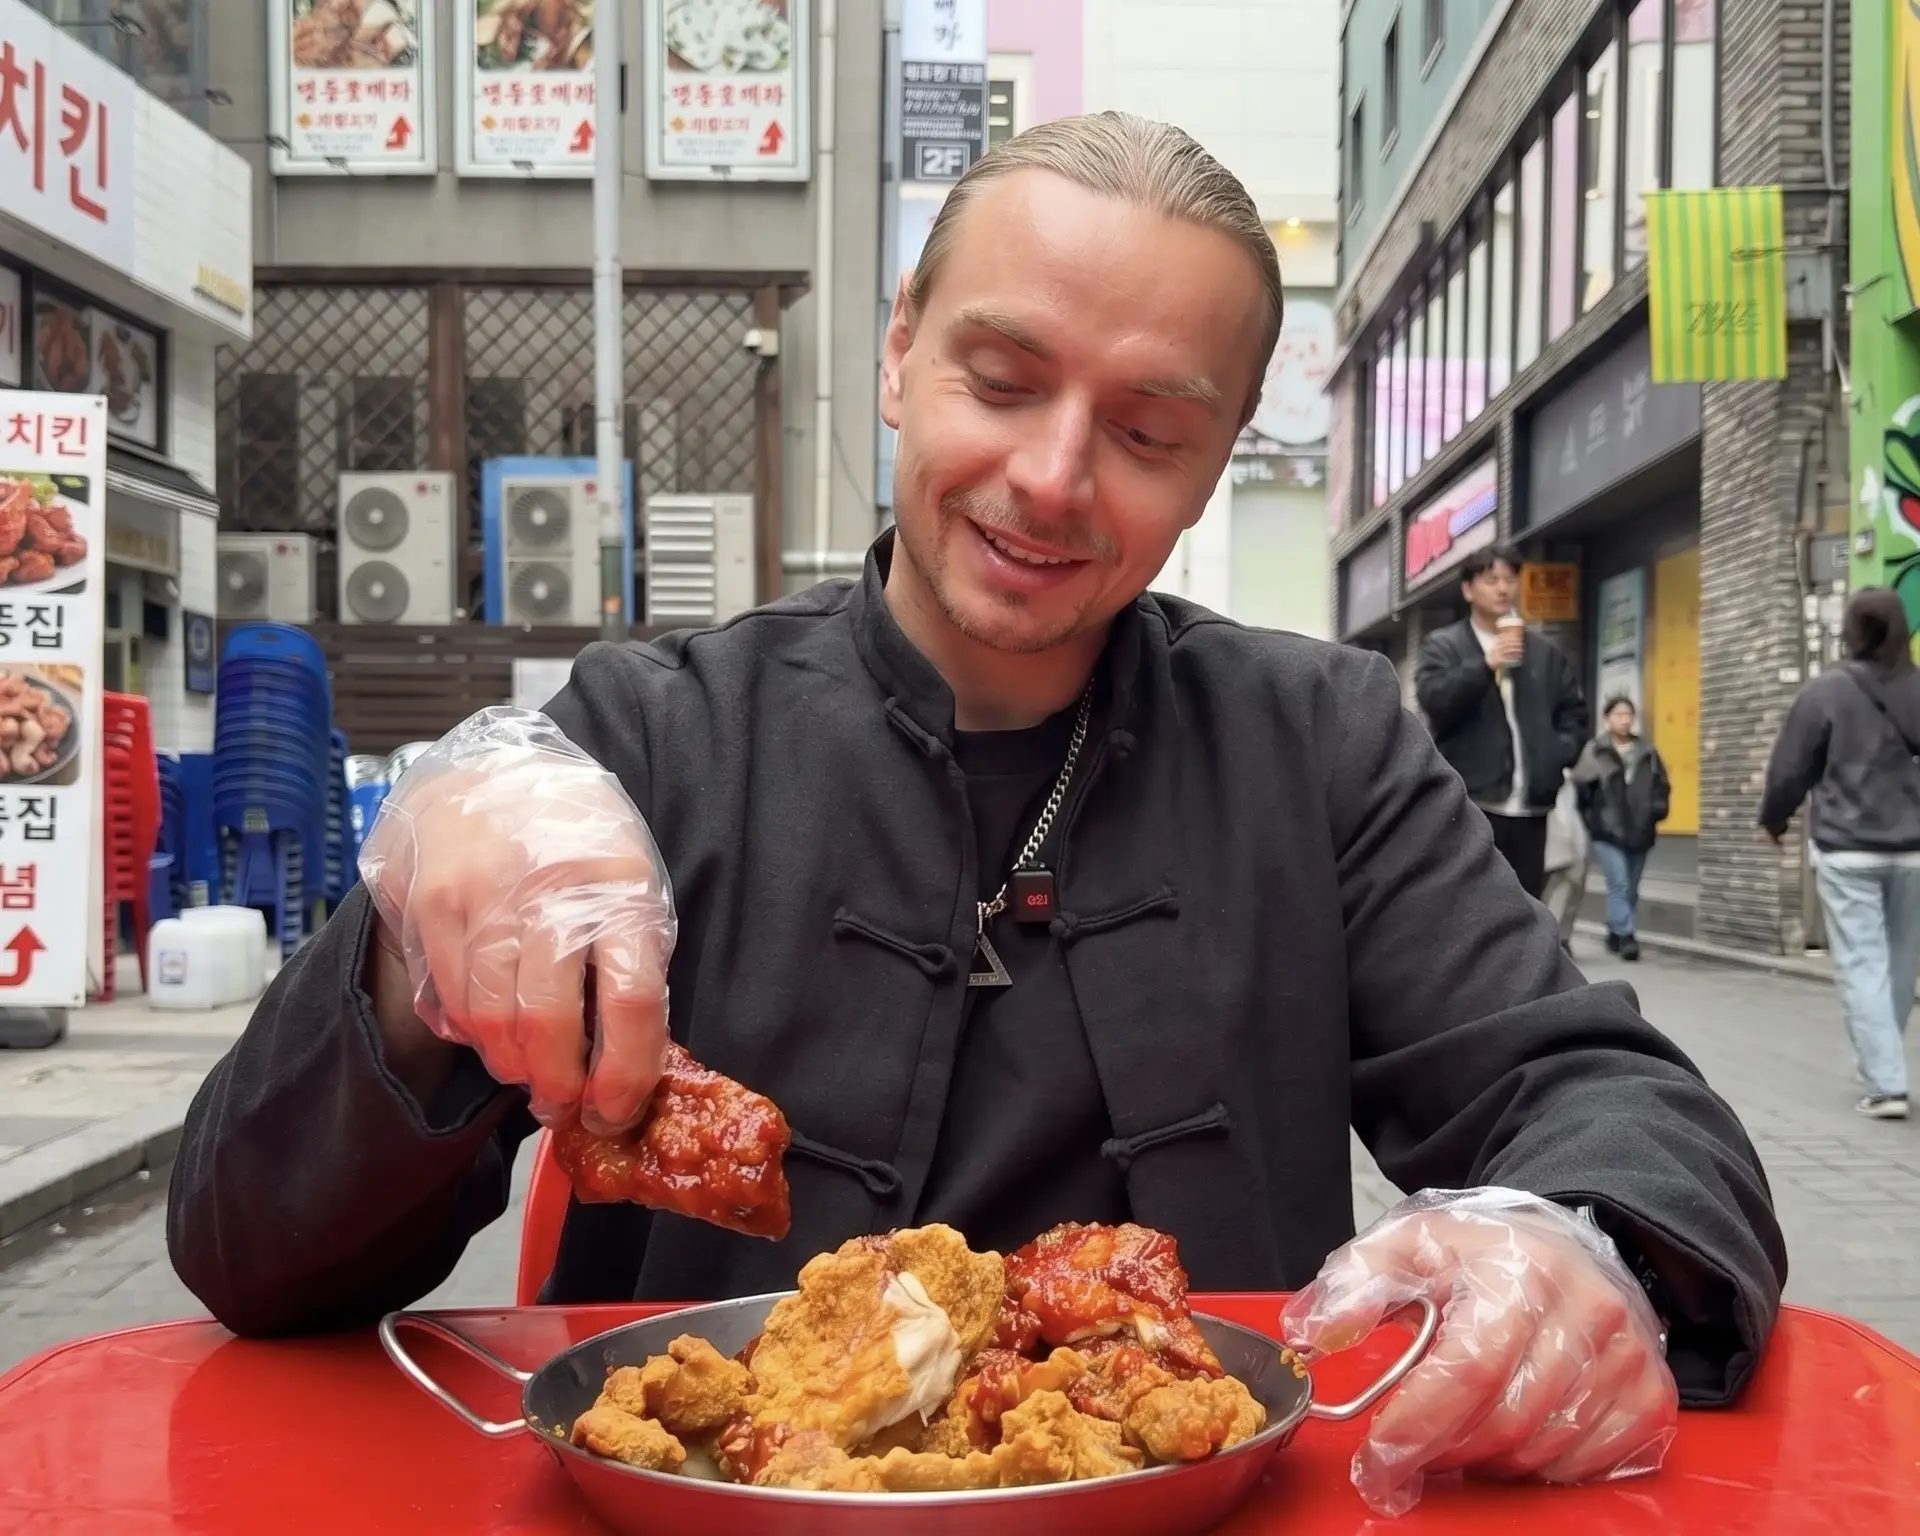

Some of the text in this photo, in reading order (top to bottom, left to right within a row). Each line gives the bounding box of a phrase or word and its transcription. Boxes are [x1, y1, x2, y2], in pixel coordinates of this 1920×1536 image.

[922, 148, 964, 175] 2F
[7, 412, 87, 457] 치킨
[0, 795, 57, 841] 집
